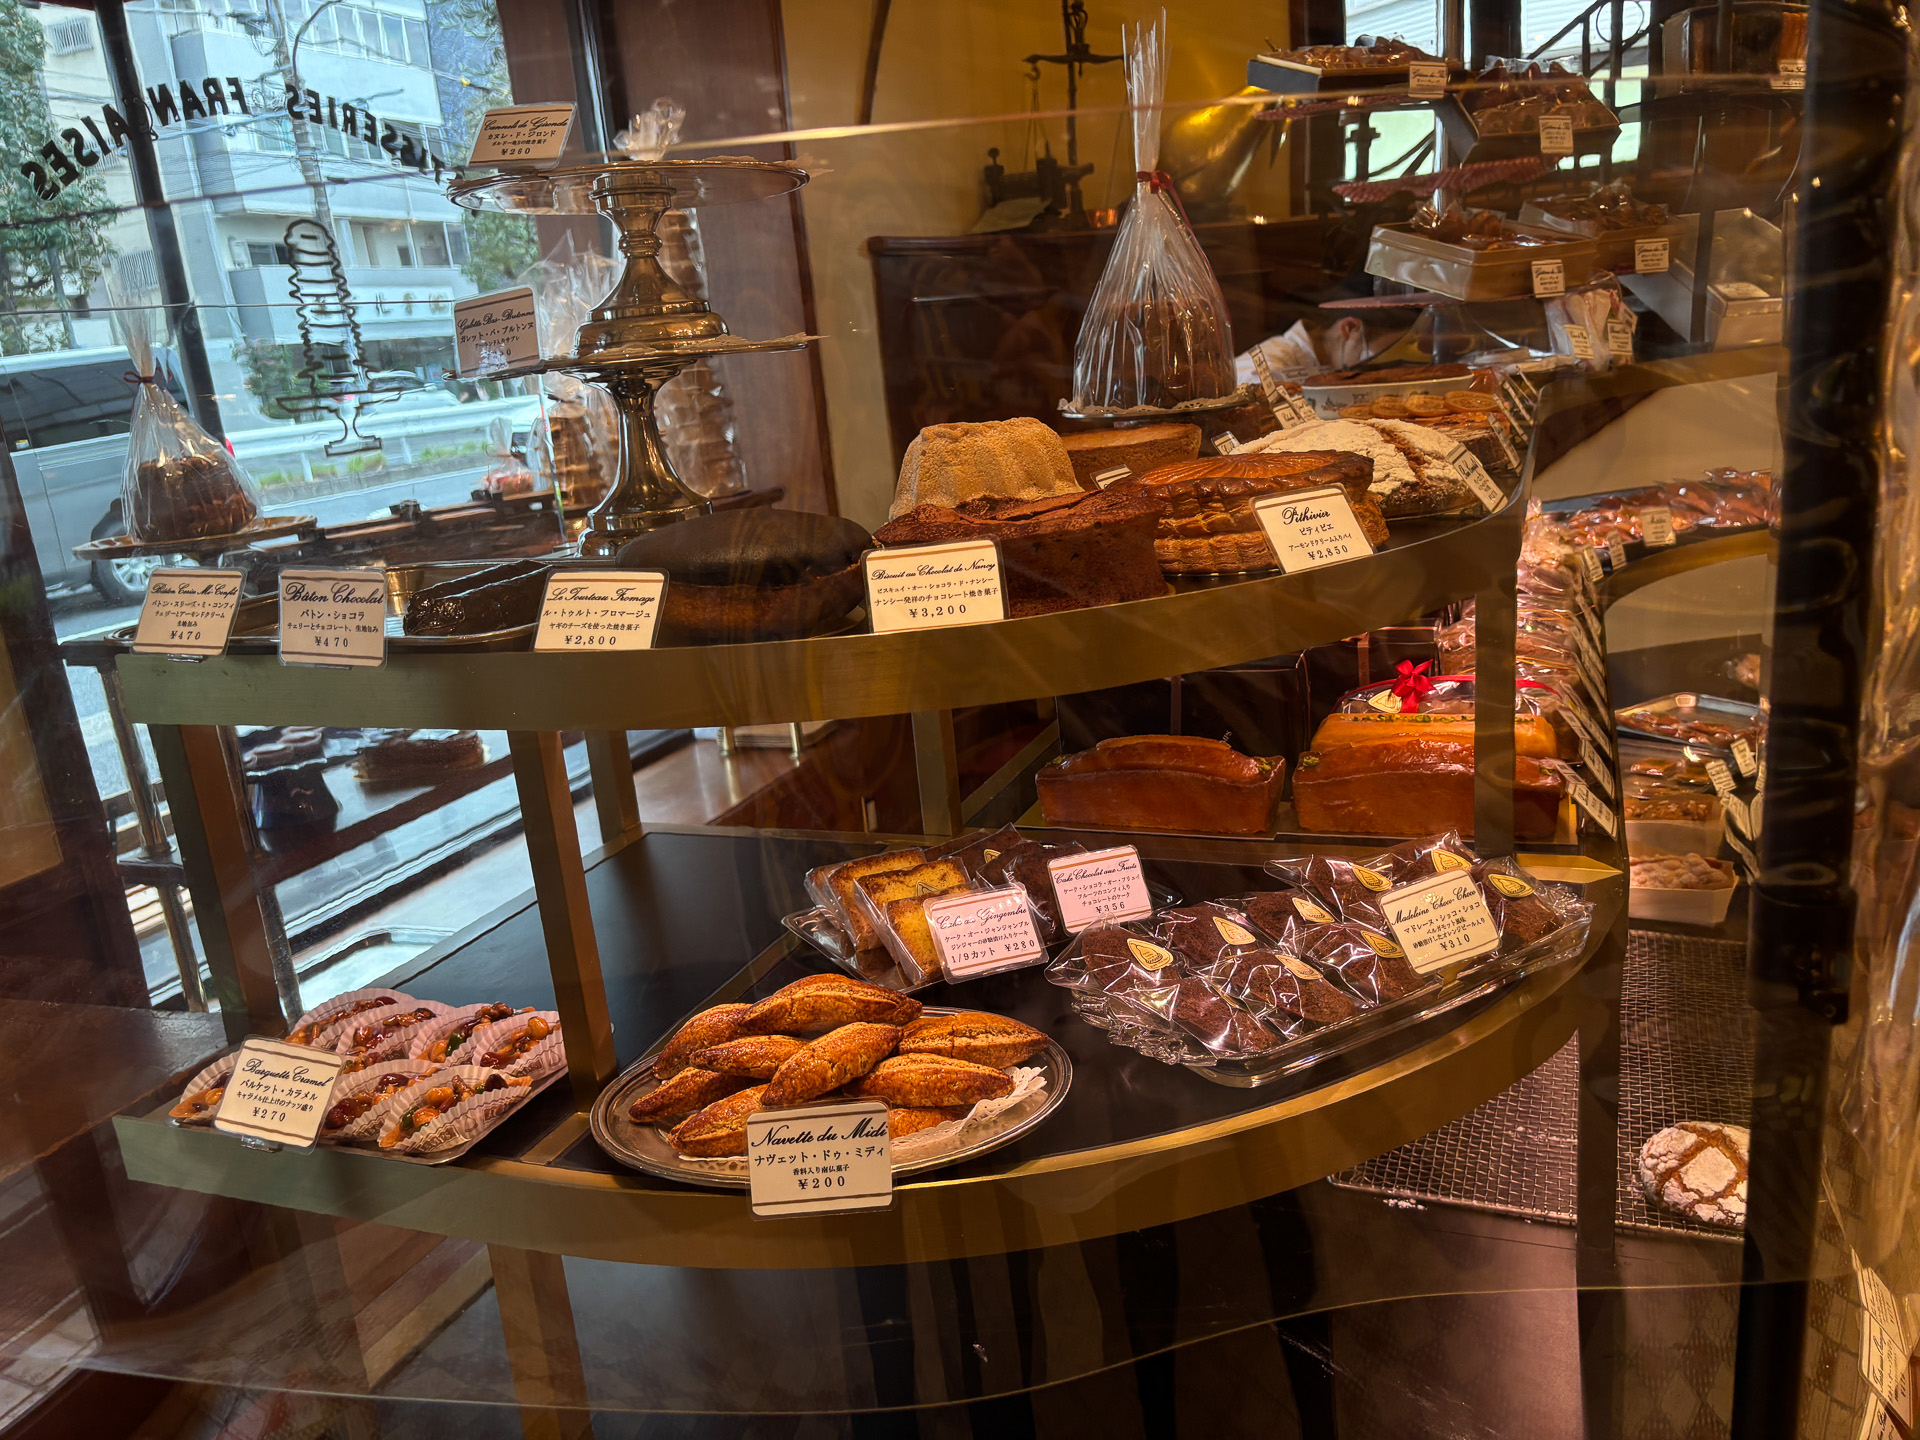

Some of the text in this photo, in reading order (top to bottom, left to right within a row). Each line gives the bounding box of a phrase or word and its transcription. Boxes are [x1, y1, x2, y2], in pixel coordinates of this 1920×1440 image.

[529, 116, 569, 132] Gironde
[487, 130, 556, 140] カヌレ・ド・ジロンド
[500, 147, 531, 156] ¥260
[457, 318, 482, 335] Galette
[460, 322, 534, 344] ガレット・バ・ブルトンヌ
[1282, 506, 1331, 526] Pithivier
[1288, 532, 1352, 552] アーモンドクリーム入りパイ
[1307, 544, 1348, 560] ¥2,850
[870, 569, 905, 580] Biscuit
[917, 564, 953, 576] Chocolat
[954, 563, 963, 573] de
[964, 558, 996, 572] Nancy
[283, 582, 384, 604] Bâton Chocolat
[546, 588, 568, 601] Le
[564, 587, 609, 601] Tourteau
[877, 577, 994, 594] ビスキュイ・オー・ショコラ・ド・ナンシー
[874, 588, 999, 607] ナンシー発祥のチョコレート焼き菓子
[300, 609, 365, 622] バトン・ショコラ
[543, 608, 651, 618] ル・トゥルト・フロマージュ
[908, 604, 967, 618] ¥3,200
[170, 630, 202, 640] ¥470
[549, 622, 640, 631] ヤギのチーズを使った焼き菓子
[315, 636, 349, 648] ¥470
[564, 635, 617, 646] ¥2,800
[1054, 872, 1074, 884] Cake
[1073, 867, 1103, 880] Chocolat
[1116, 859, 1137, 872] Fruits
[1064, 874, 1140, 894] ケーク・ショコラ・オー・フリュイ
[1078, 884, 1131, 900] フルーツのコンフィ入り
[976, 904, 1027, 926] Gingembre
[1392, 906, 1430, 926] Madeleine
[1404, 902, 1481, 934] マドレーヌ・ショコ・ショコ
[944, 921, 1030, 942] ケーク・オー・ジャンジャンブル
[951, 930, 1029, 951] ジンジャーの砂糖漬け入りケーキ
[1440, 933, 1470, 951] ¥310
[951, 940, 1035, 964] 1/9カット ¥280
[242, 1058, 290, 1081] Barquette
[240, 1080, 318, 1101] バルケット・カラメル
[236, 1090, 314, 1112] キャラメル仕上げのナッツ盛り
[252, 1106, 286, 1122] ¥270
[751, 1117, 888, 1147] Navette du Midi
[754, 1146, 884, 1167] ナヴェット・ドゥ・ミディ
[792, 1164, 850, 1176] 香料入り南仏菓子
[798, 1176, 846, 1190] ¥200
